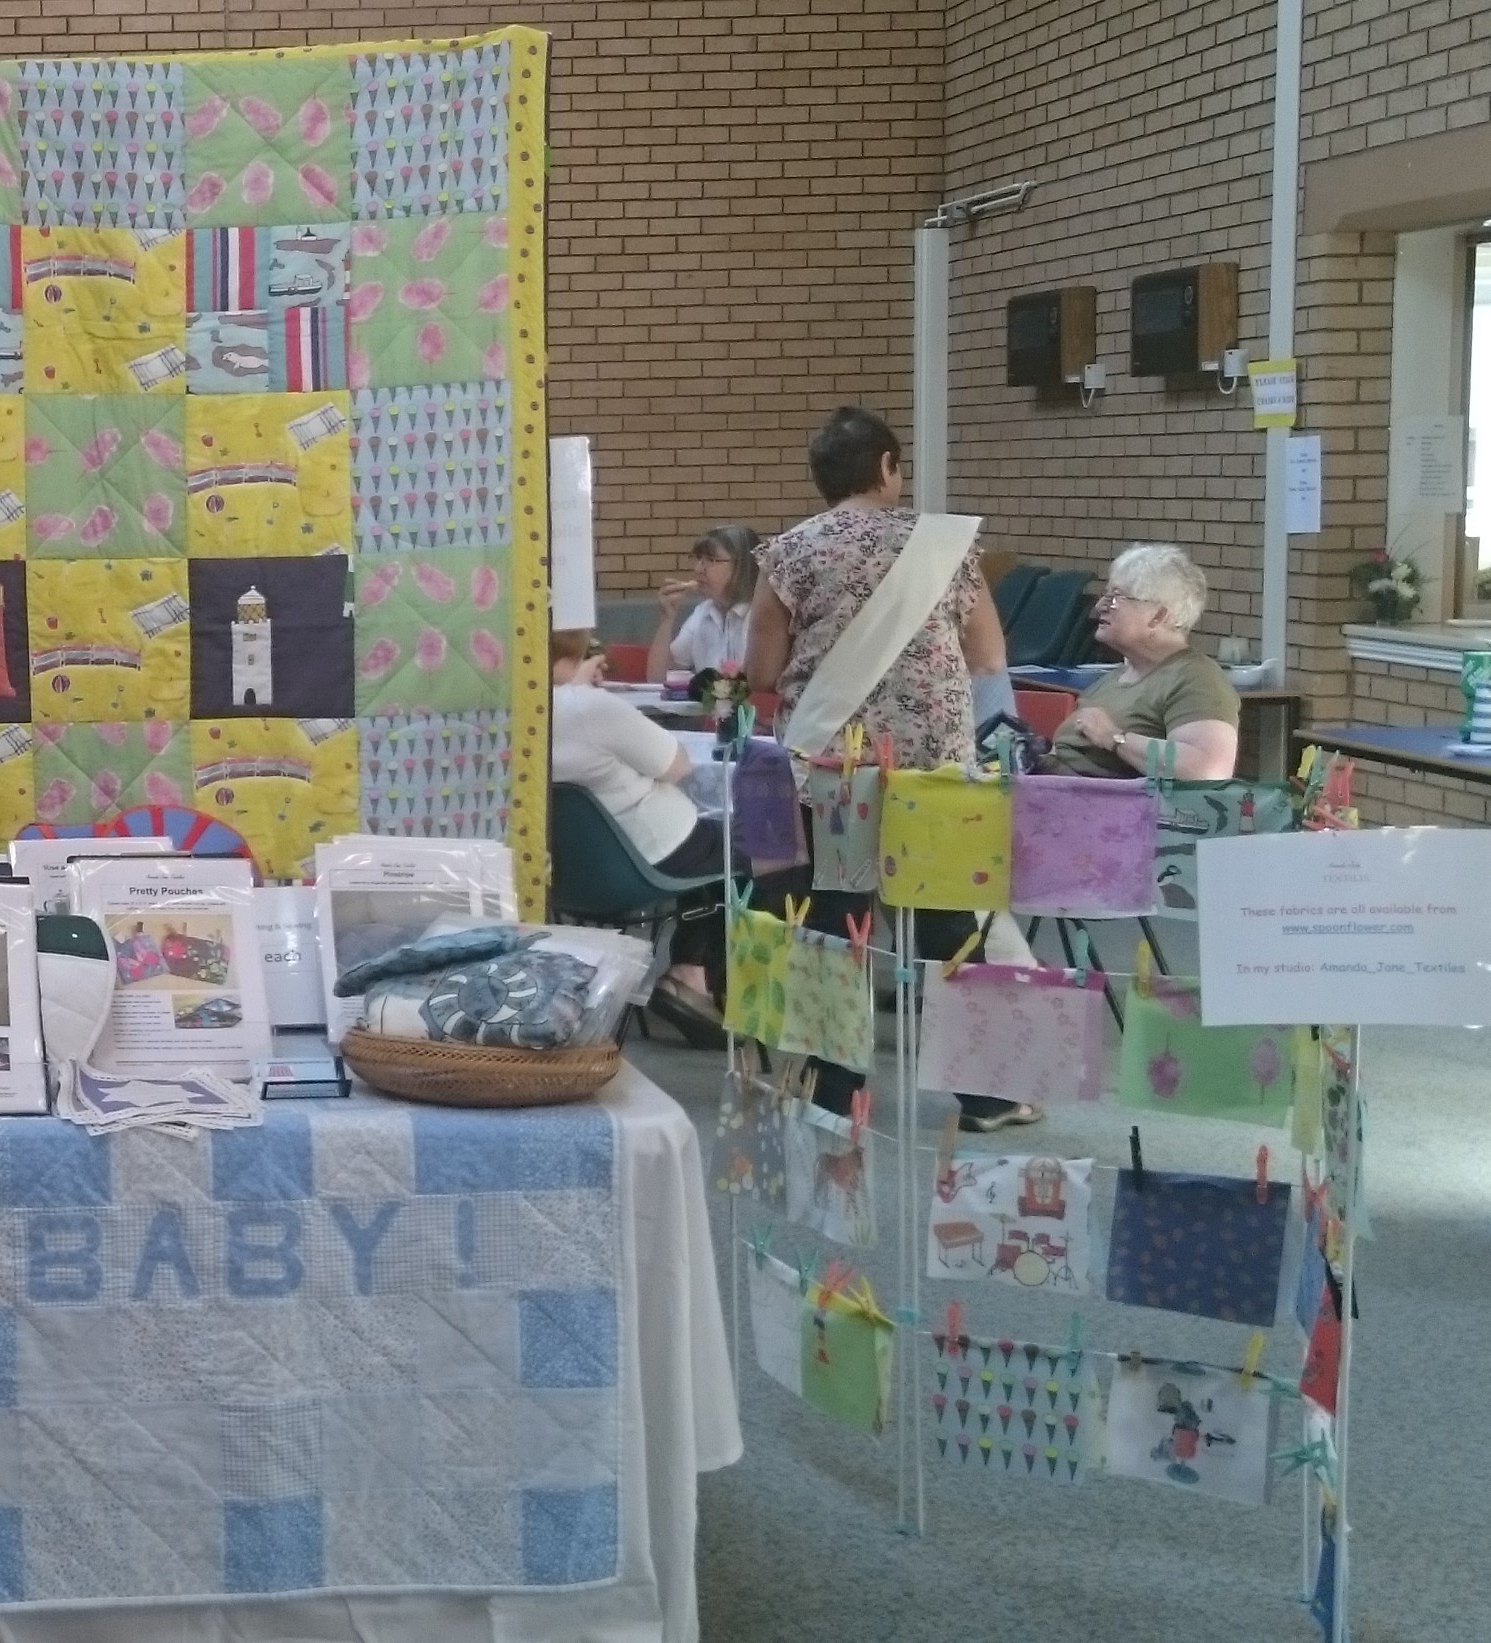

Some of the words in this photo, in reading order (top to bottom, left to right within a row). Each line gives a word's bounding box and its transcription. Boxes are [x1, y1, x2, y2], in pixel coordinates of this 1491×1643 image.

[129, 887, 159, 896] Pretty
[161, 887, 204, 896] Pouches
[1240, 907, 1275, 917] These
[1279, 905, 1323, 916] fabrics
[1327, 907, 1347, 915] are
[1351, 904, 1365, 914] all
[1369, 904, 1422, 915] available
[1427, 904, 1457, 915] from
[1282, 921, 1414, 935] www.spoonflower.com
[264, 949, 301, 963] each
[1236, 964, 1250, 975] In
[1253, 966, 1269, 976] my
[1274, 963, 1315, 974] studio:
[1320, 961, 1466, 975] Amanda_Jane_Textiles
